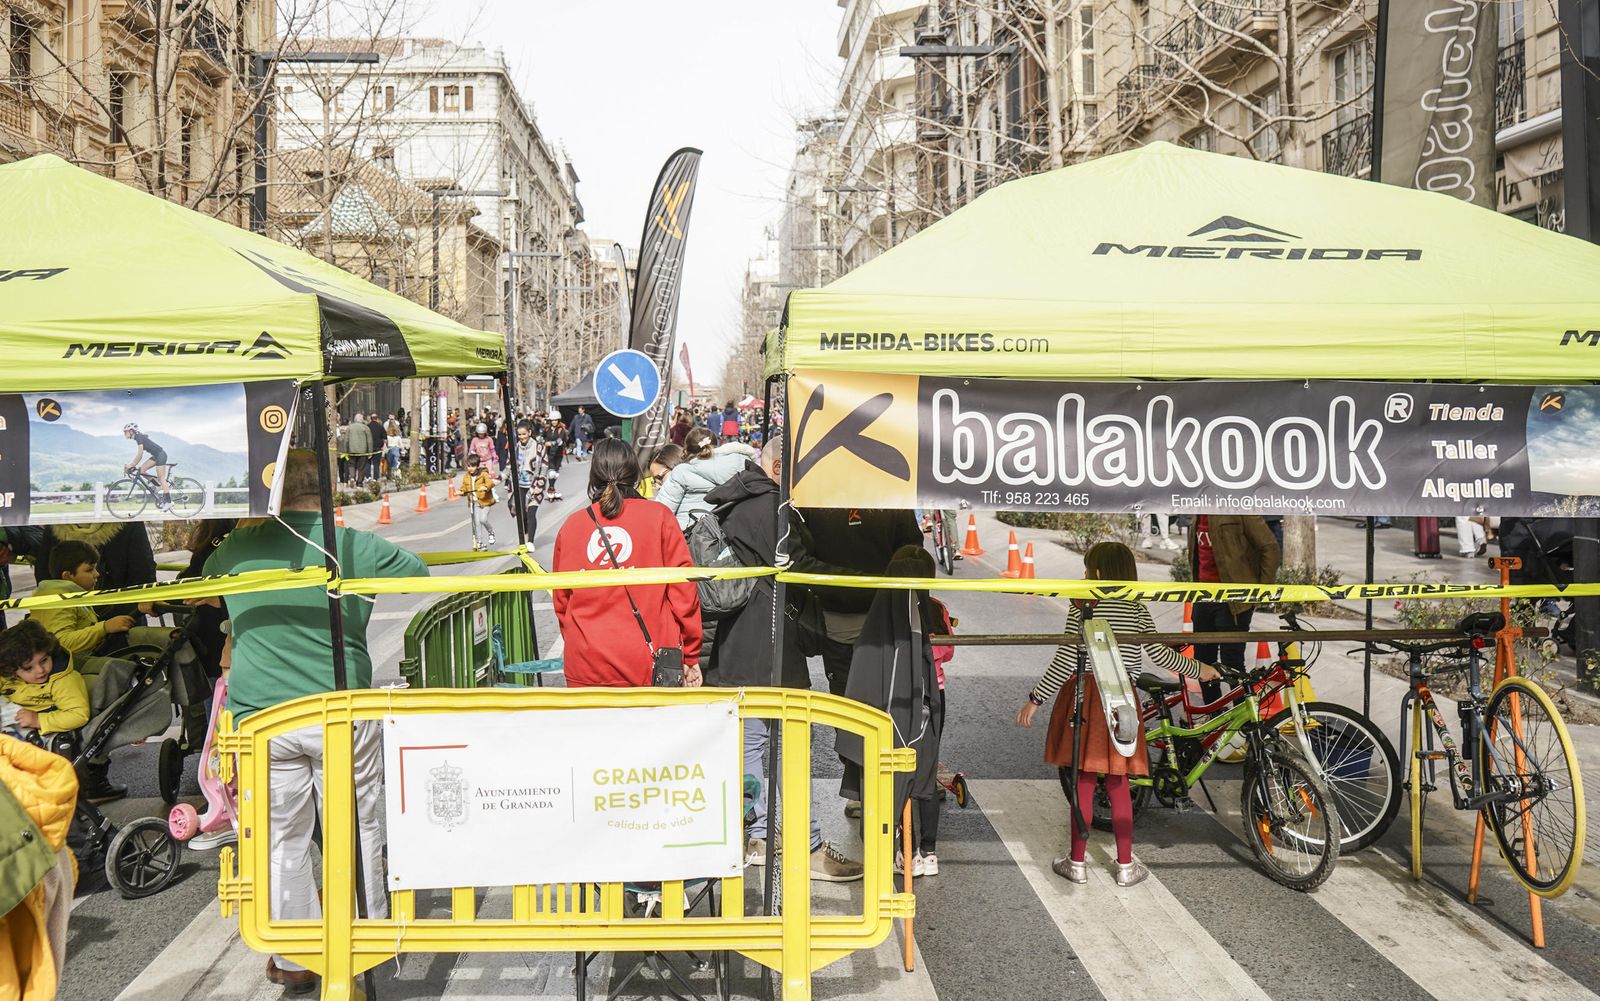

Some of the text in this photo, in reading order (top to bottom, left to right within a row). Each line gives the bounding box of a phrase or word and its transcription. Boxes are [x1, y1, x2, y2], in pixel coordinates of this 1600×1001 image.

[1092, 242, 1423, 261] MERIDA
[63, 340, 242, 360] MERIDA
[820, 332, 1049, 353] MERIDA-BIKES.com
[1429, 403, 1504, 421] Tienda
[932, 388, 1387, 491] balakook
[1431, 439, 1498, 459] Taller
[981, 490, 1089, 506] Tlf: 958 223 465
[1421, 478, 1515, 502] Alquiler
[1171, 494, 1346, 511] Email: info@balakook.com
[593, 763, 706, 786] GRANADA
[594, 787, 706, 812] RESPIRA
[607, 815, 694, 831] calidad de vida
